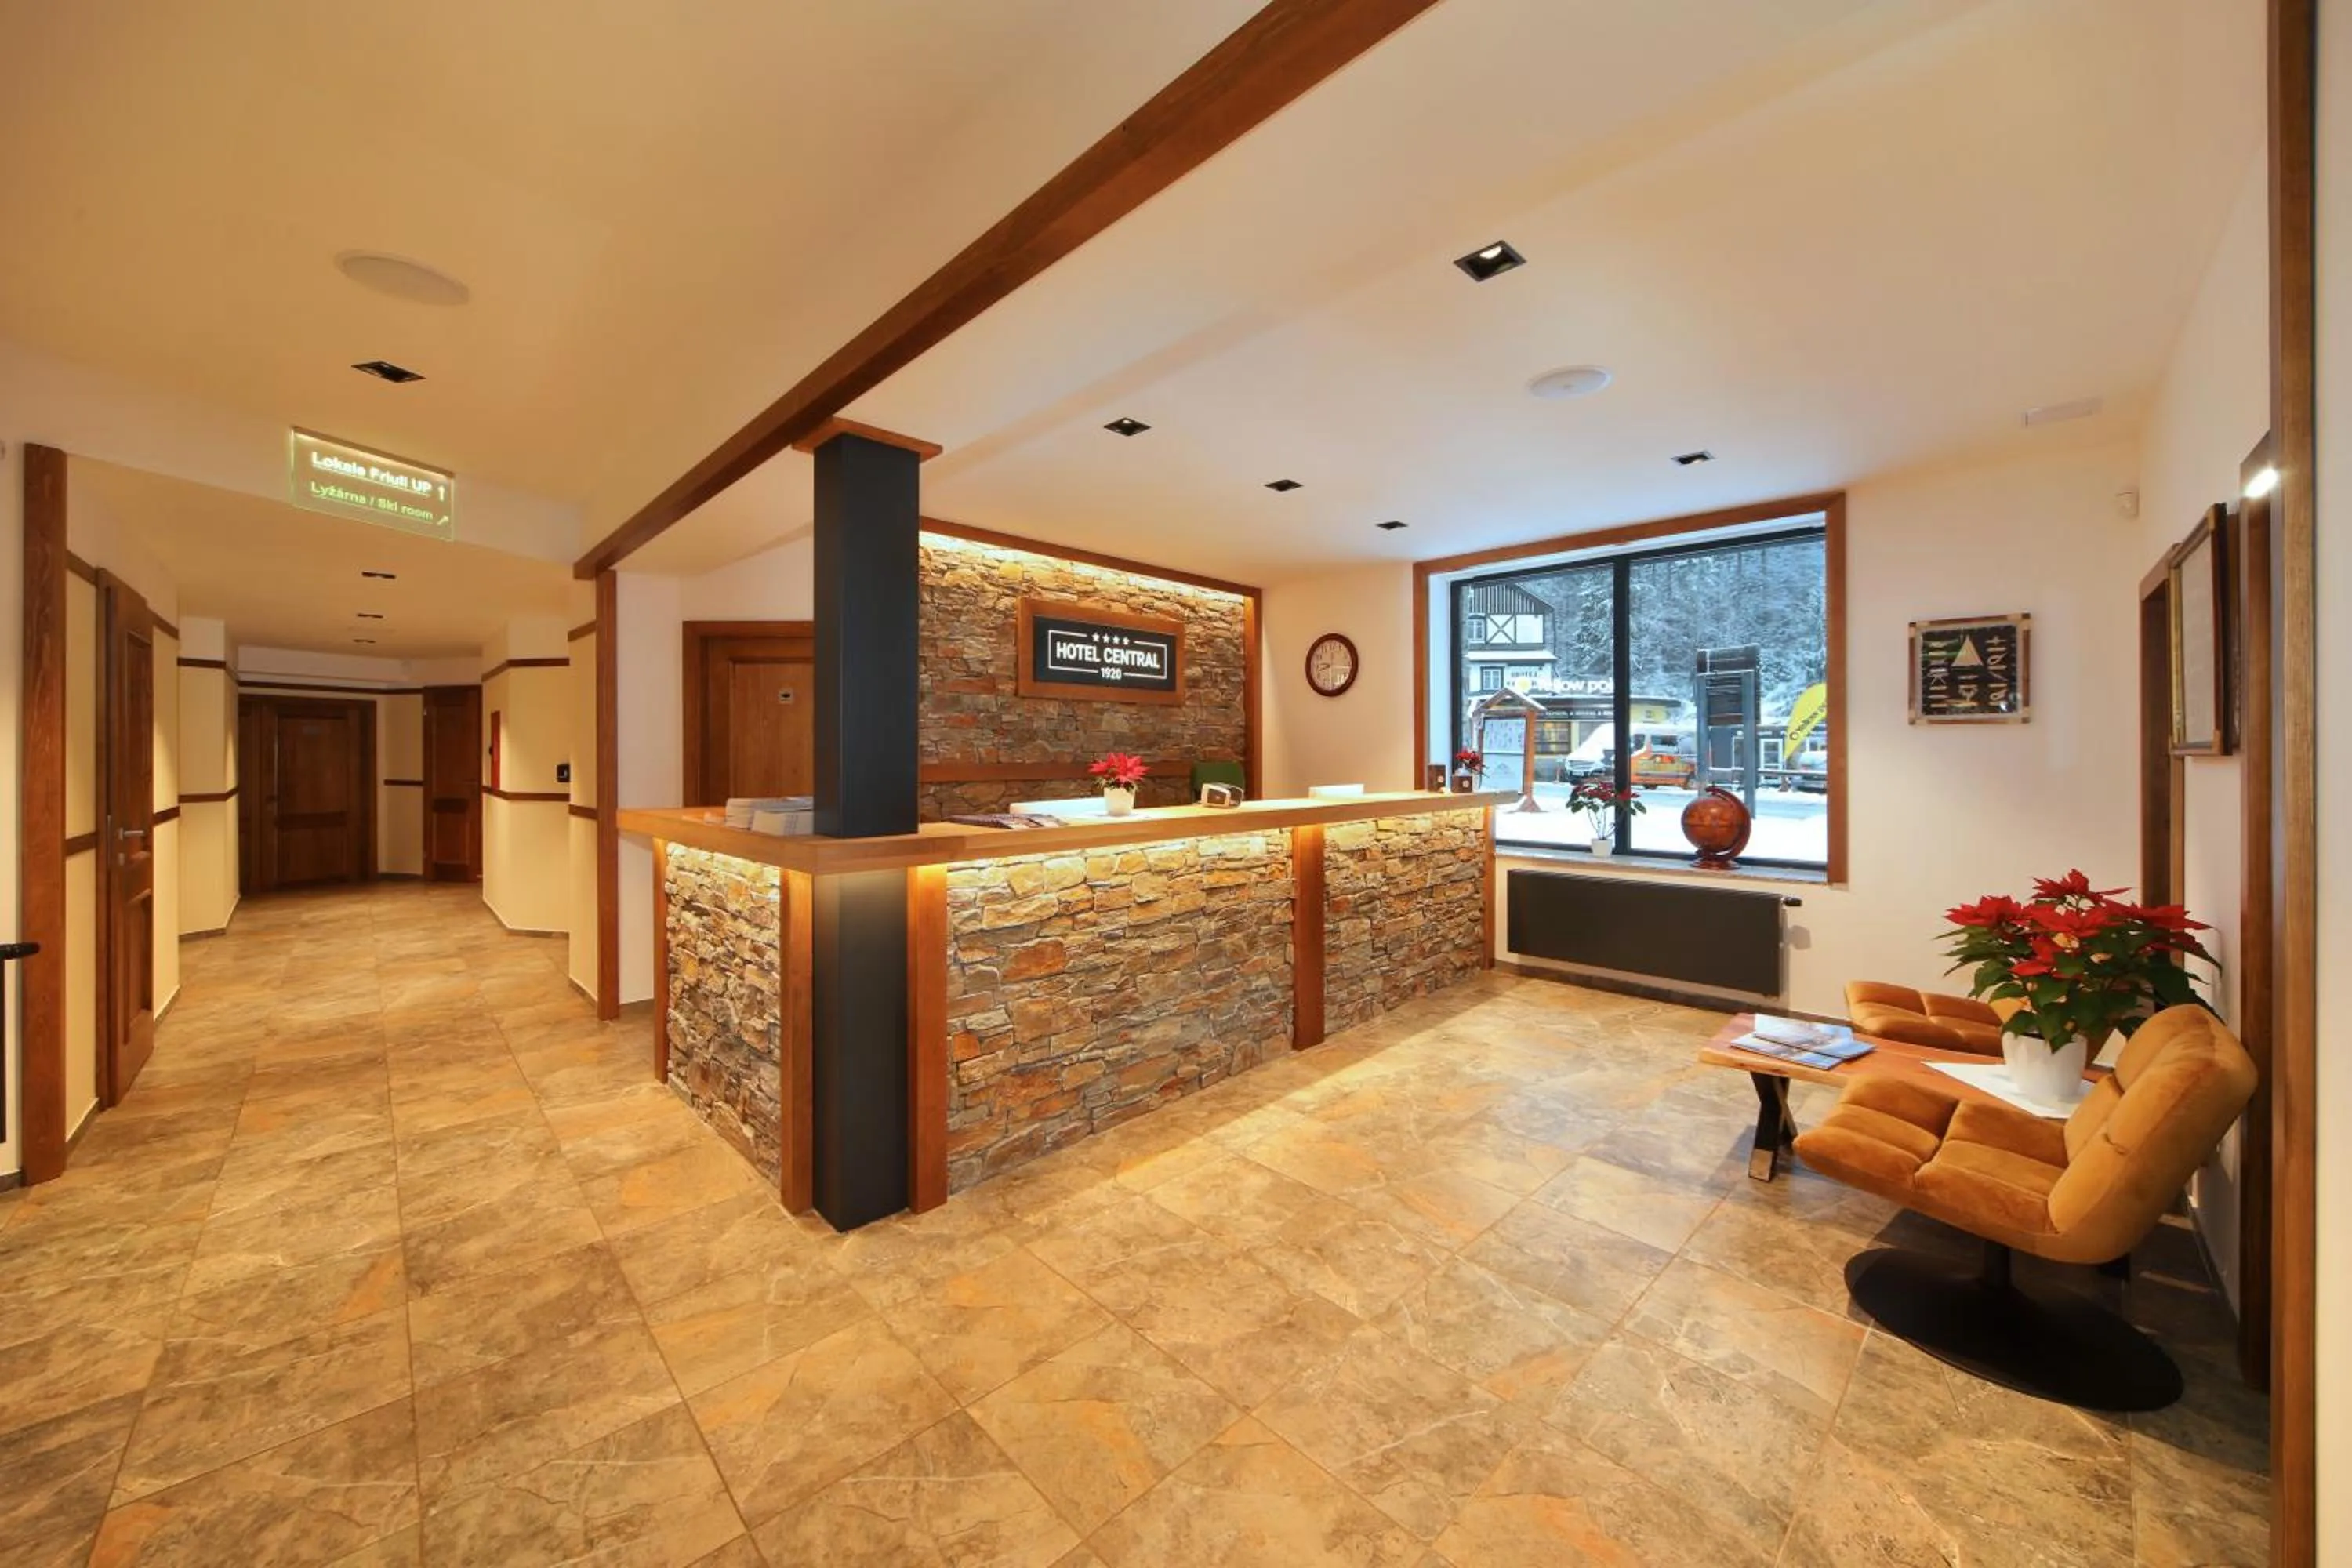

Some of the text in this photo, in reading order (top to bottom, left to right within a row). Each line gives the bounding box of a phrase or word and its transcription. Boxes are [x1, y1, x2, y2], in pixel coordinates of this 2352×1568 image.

[412, 478, 433, 494] UP
[378, 498, 397, 513] Ski
[401, 506, 434, 521] room
[1055, 641, 1160, 669] HOTEL CENTRAL
[1101, 667, 1122, 680] 1920
